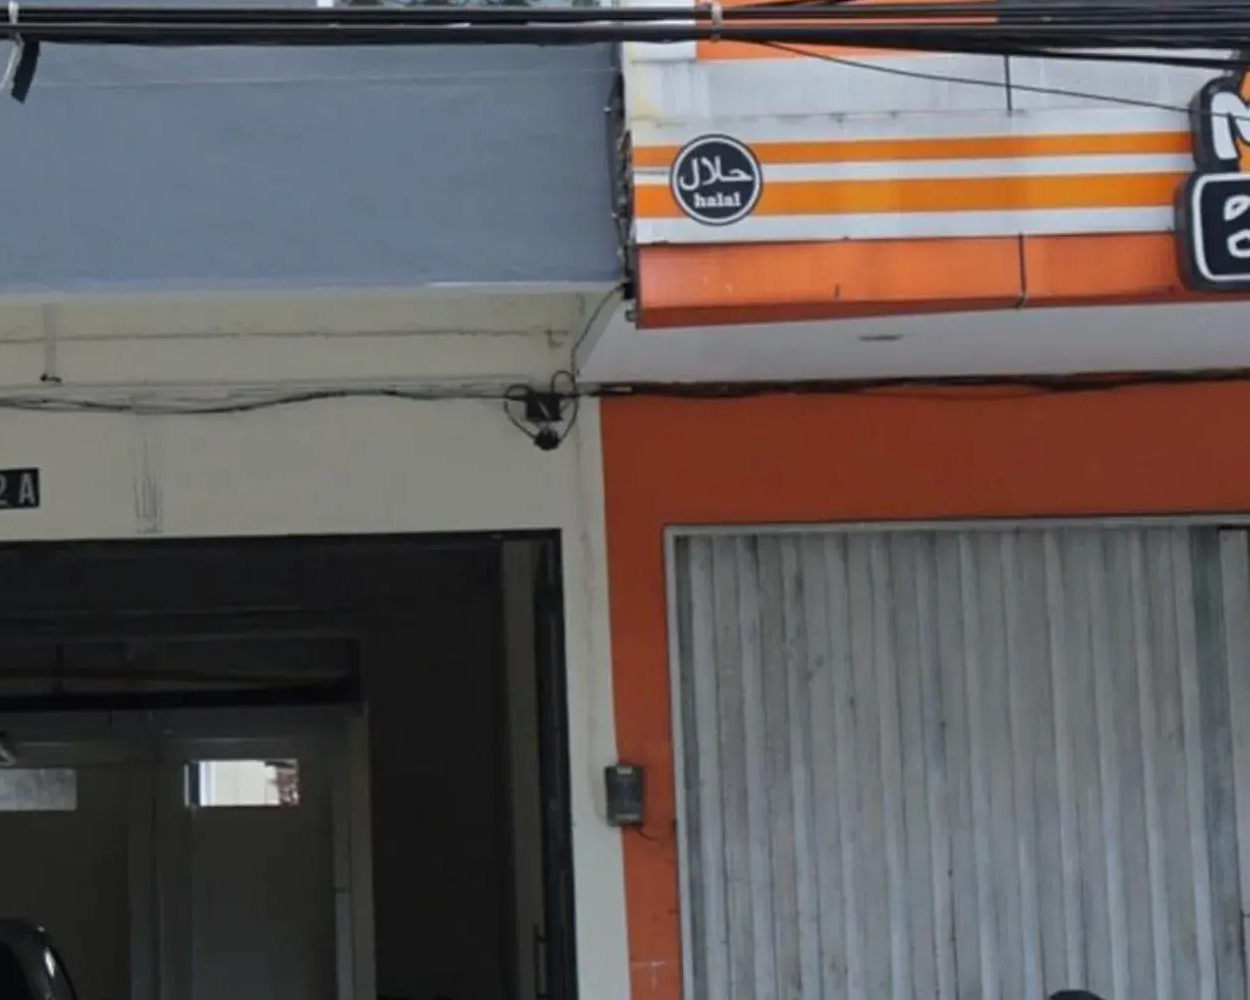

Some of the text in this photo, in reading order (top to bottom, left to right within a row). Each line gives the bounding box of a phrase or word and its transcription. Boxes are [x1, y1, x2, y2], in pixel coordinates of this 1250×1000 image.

[679, 154, 753, 191] حلال
[693, 191, 742, 209] halal
[18, 472, 36, 505] A
